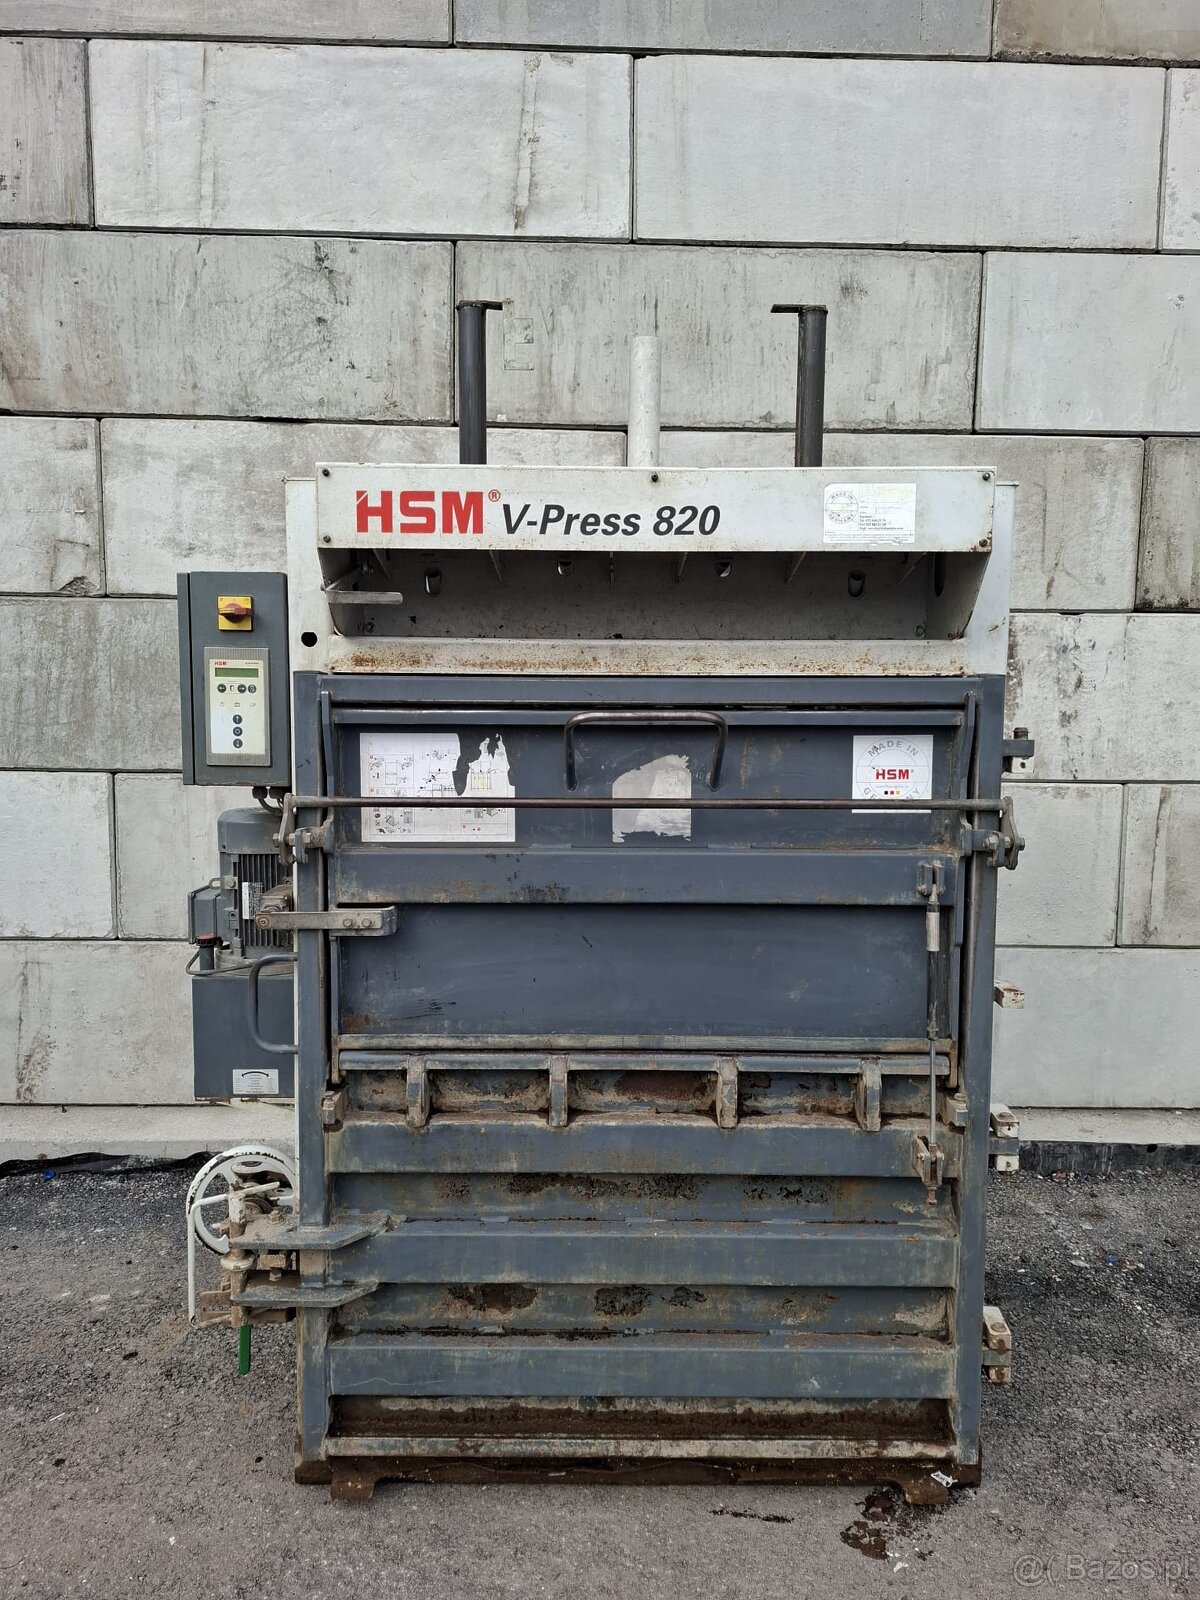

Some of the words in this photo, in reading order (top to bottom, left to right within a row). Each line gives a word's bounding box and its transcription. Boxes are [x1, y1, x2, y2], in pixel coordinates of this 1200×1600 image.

[502, 504, 641, 536] V-Press
[653, 505, 720, 536] 820
[868, 740, 903, 757] MADE
[906, 744, 920, 757] IN
